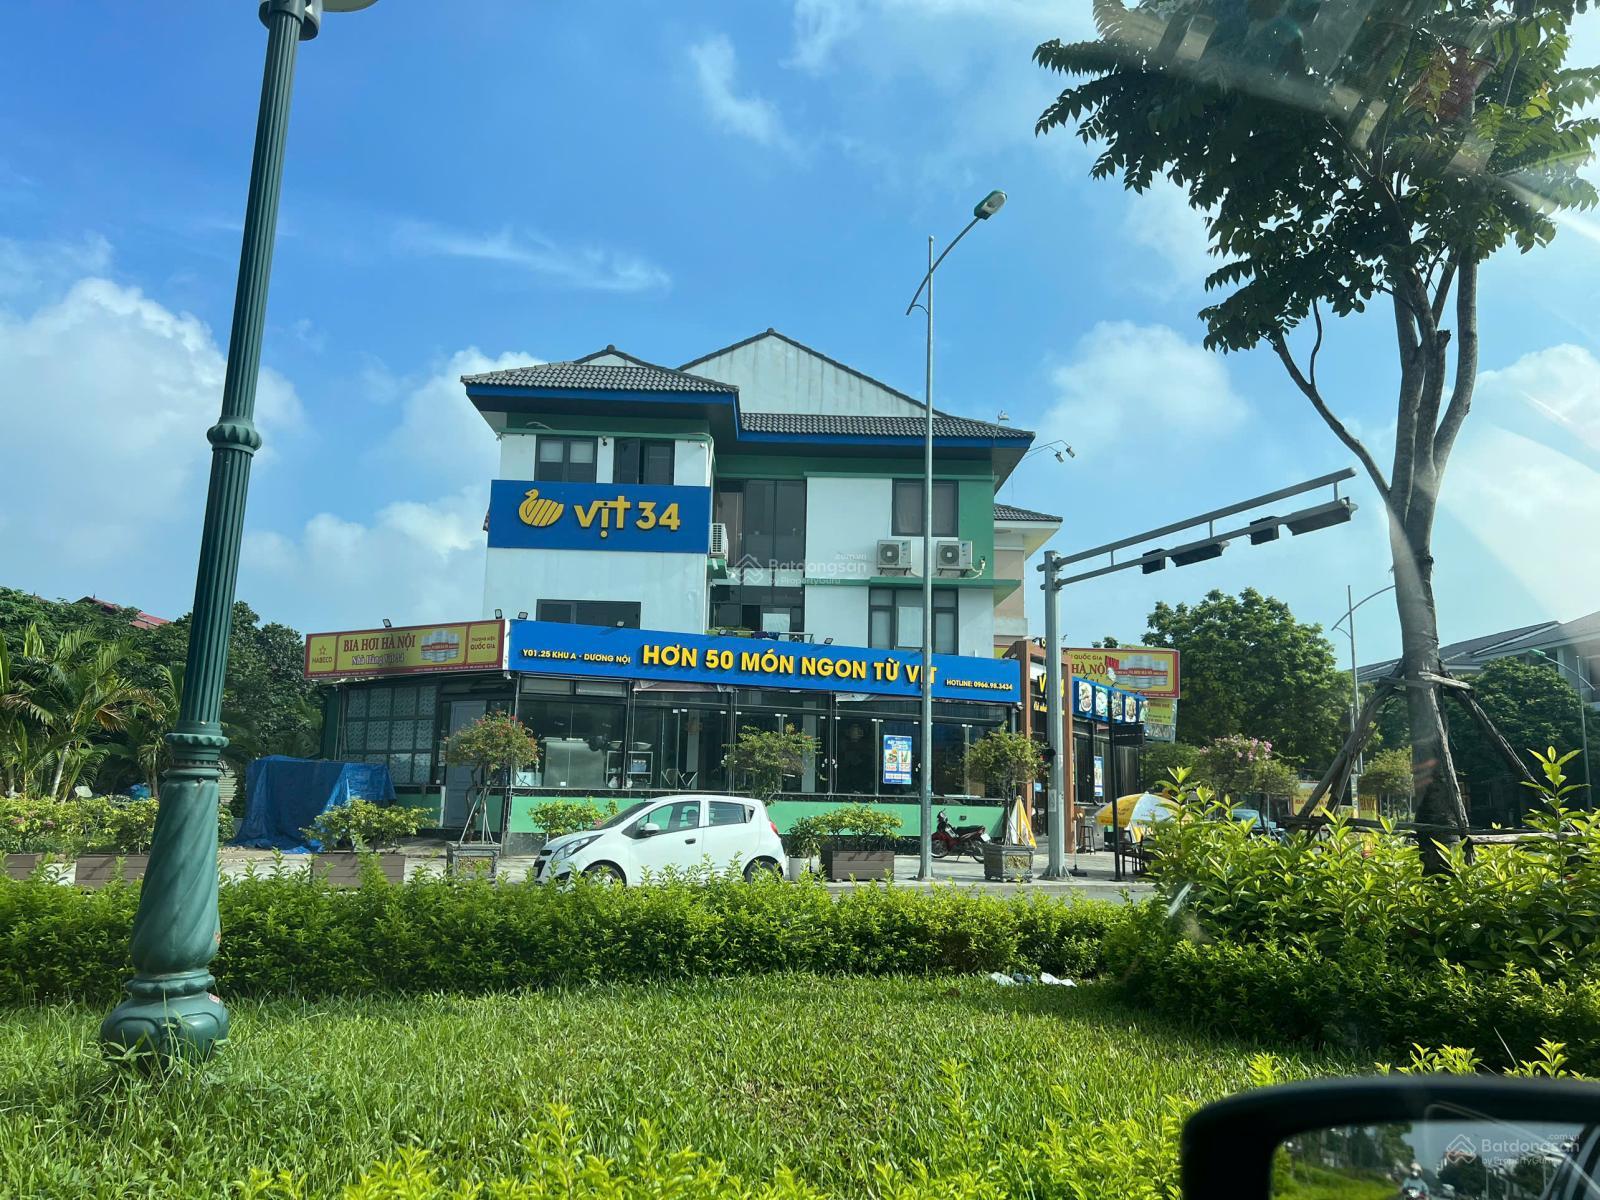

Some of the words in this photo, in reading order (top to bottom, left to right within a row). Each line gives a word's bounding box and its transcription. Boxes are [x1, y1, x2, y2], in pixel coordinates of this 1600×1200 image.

[343, 639, 359, 652] BIA
[361, 637, 380, 651] HƠI
[381, 634, 396, 649] HÀ
[397, 632, 416, 651] NỘI
[522, 648, 551, 658] Y01.25
[552, 650, 569, 659] KHU
[570, 652, 577, 660] A
[615, 654, 631, 665] NỘI
[642, 643, 697, 668] HƠN
[705, 649, 734, 669] 50
[741, 647, 794, 675] MÓN
[801, 656, 867, 680] NGON
[874, 657, 900, 682] TỪ
[1071, 661, 1086, 674] HÀ
